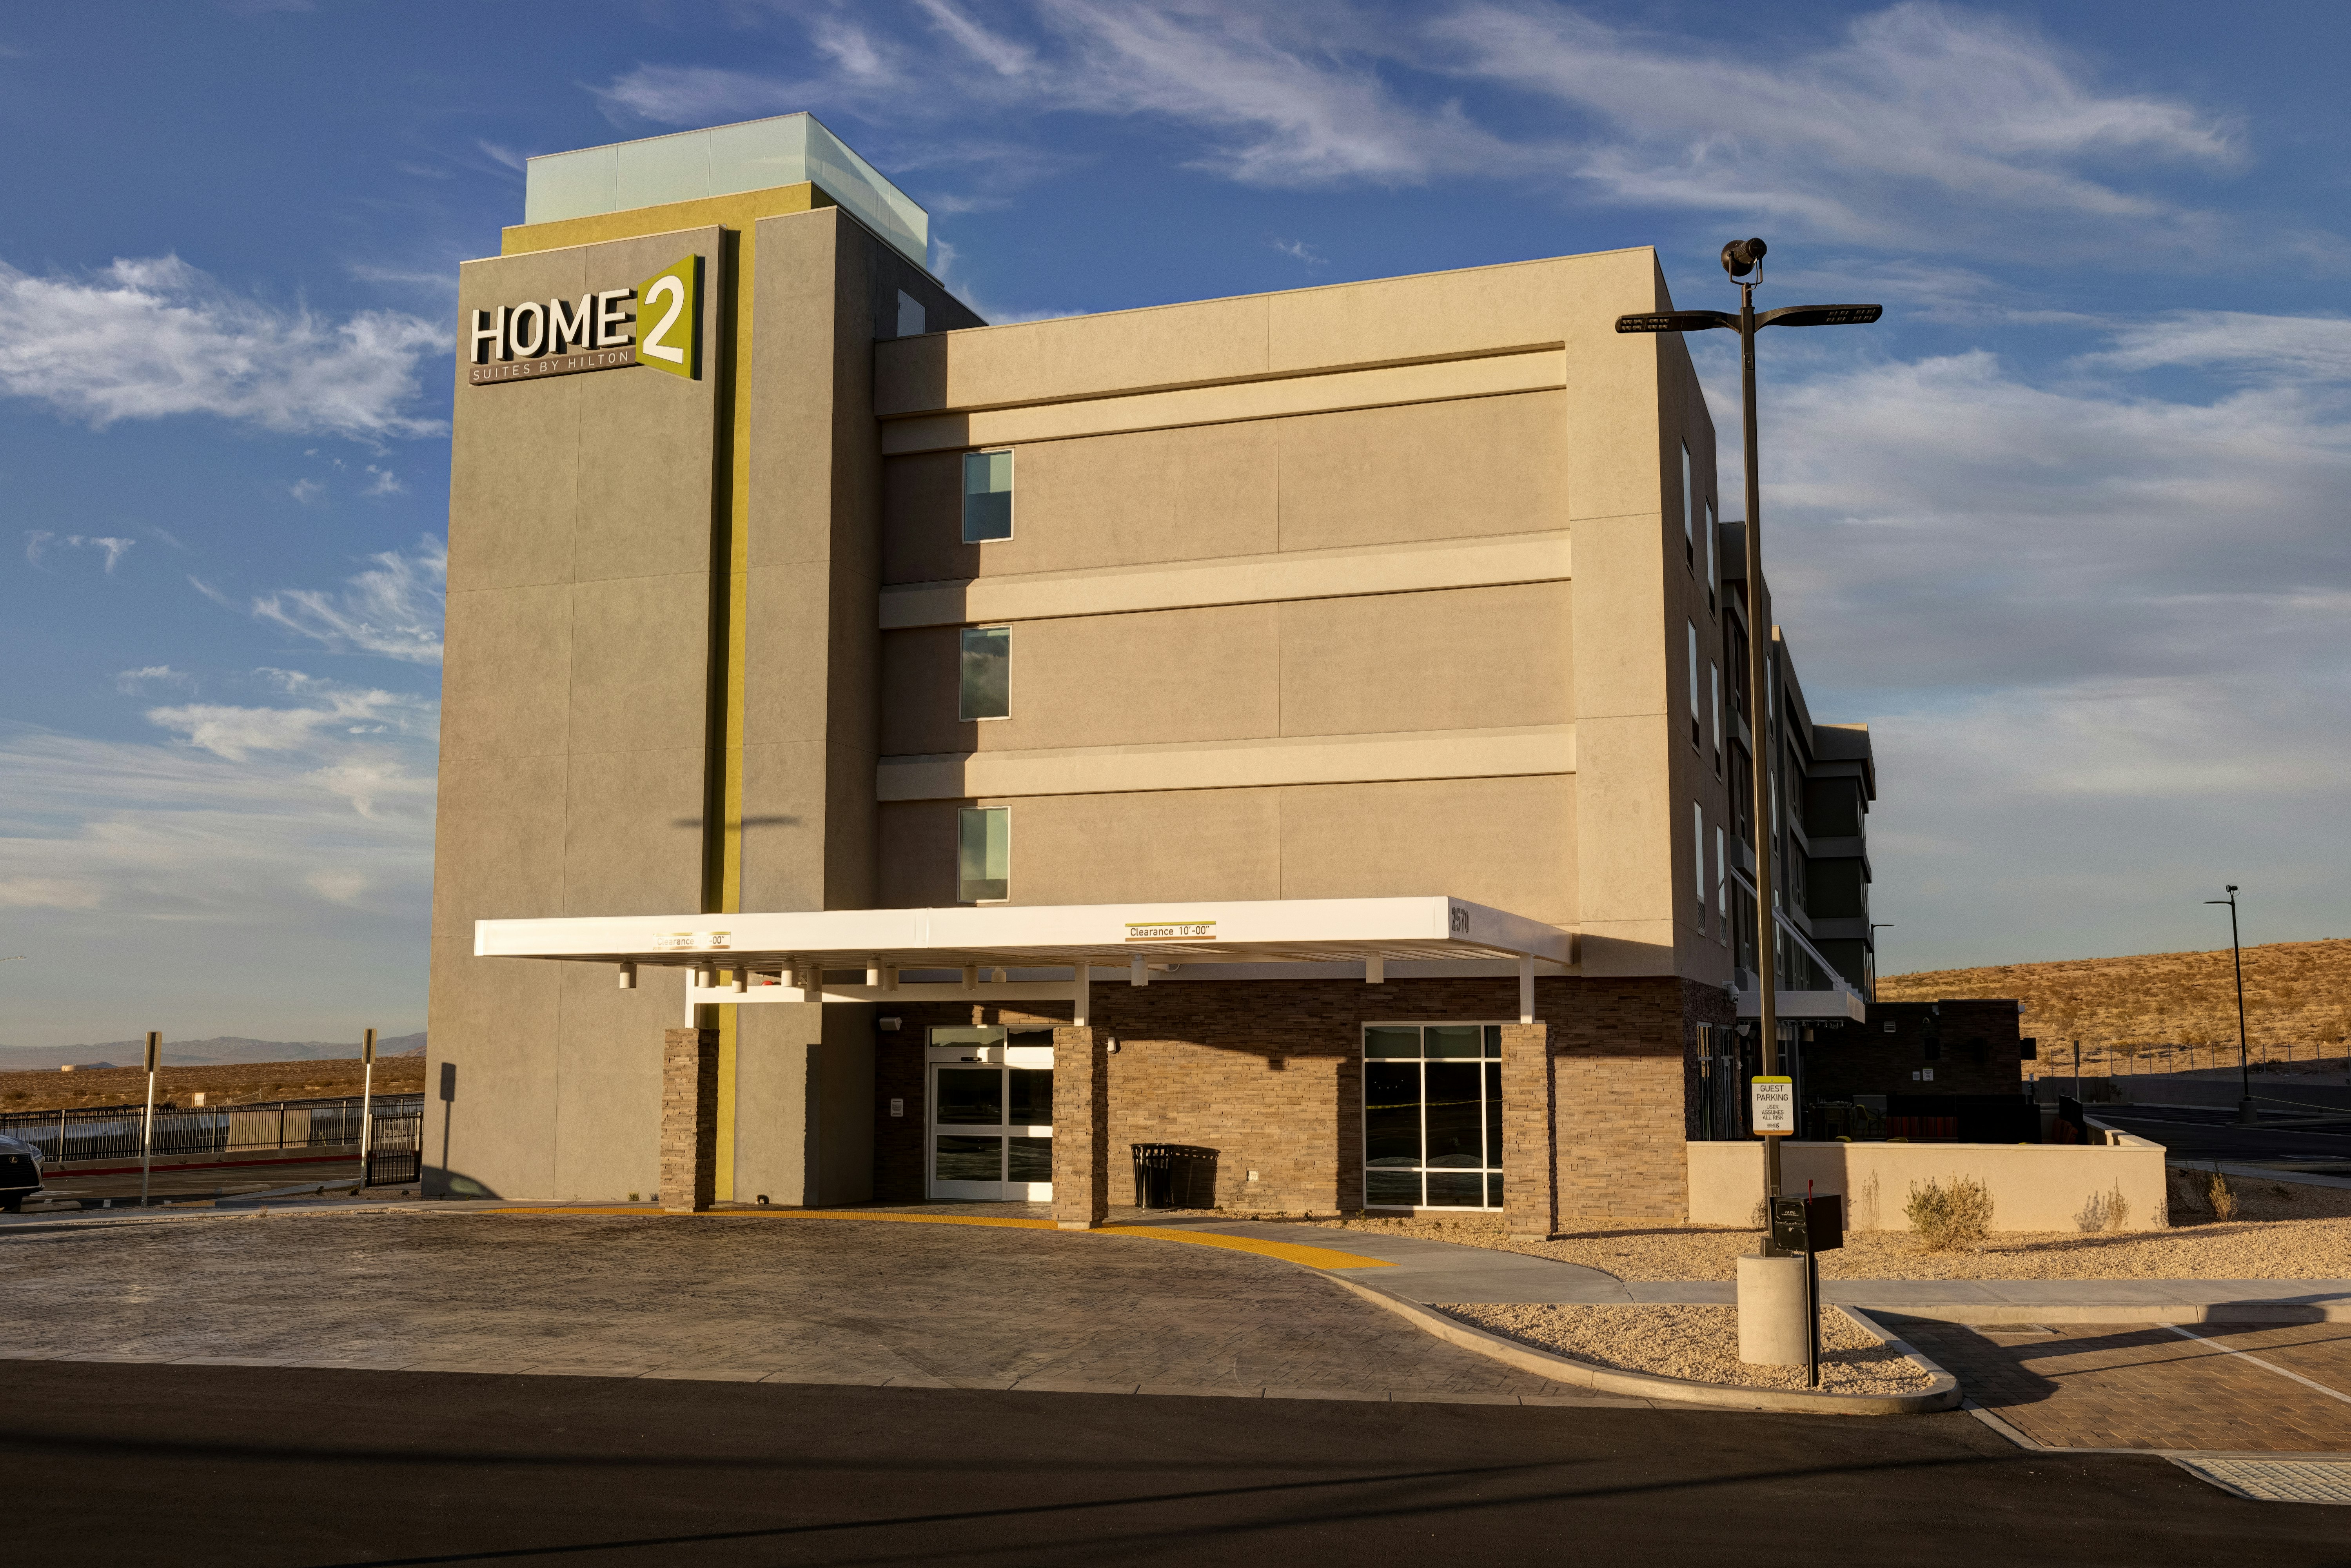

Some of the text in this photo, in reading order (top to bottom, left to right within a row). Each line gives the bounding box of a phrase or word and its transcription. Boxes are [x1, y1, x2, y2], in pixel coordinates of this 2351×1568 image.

[473, 351, 628, 380] SUITES BY HILTON
[1452, 906, 1469, 934] 2570
[1130, 927, 1174, 936] Clearance
[657, 937, 694, 946] Clearance
